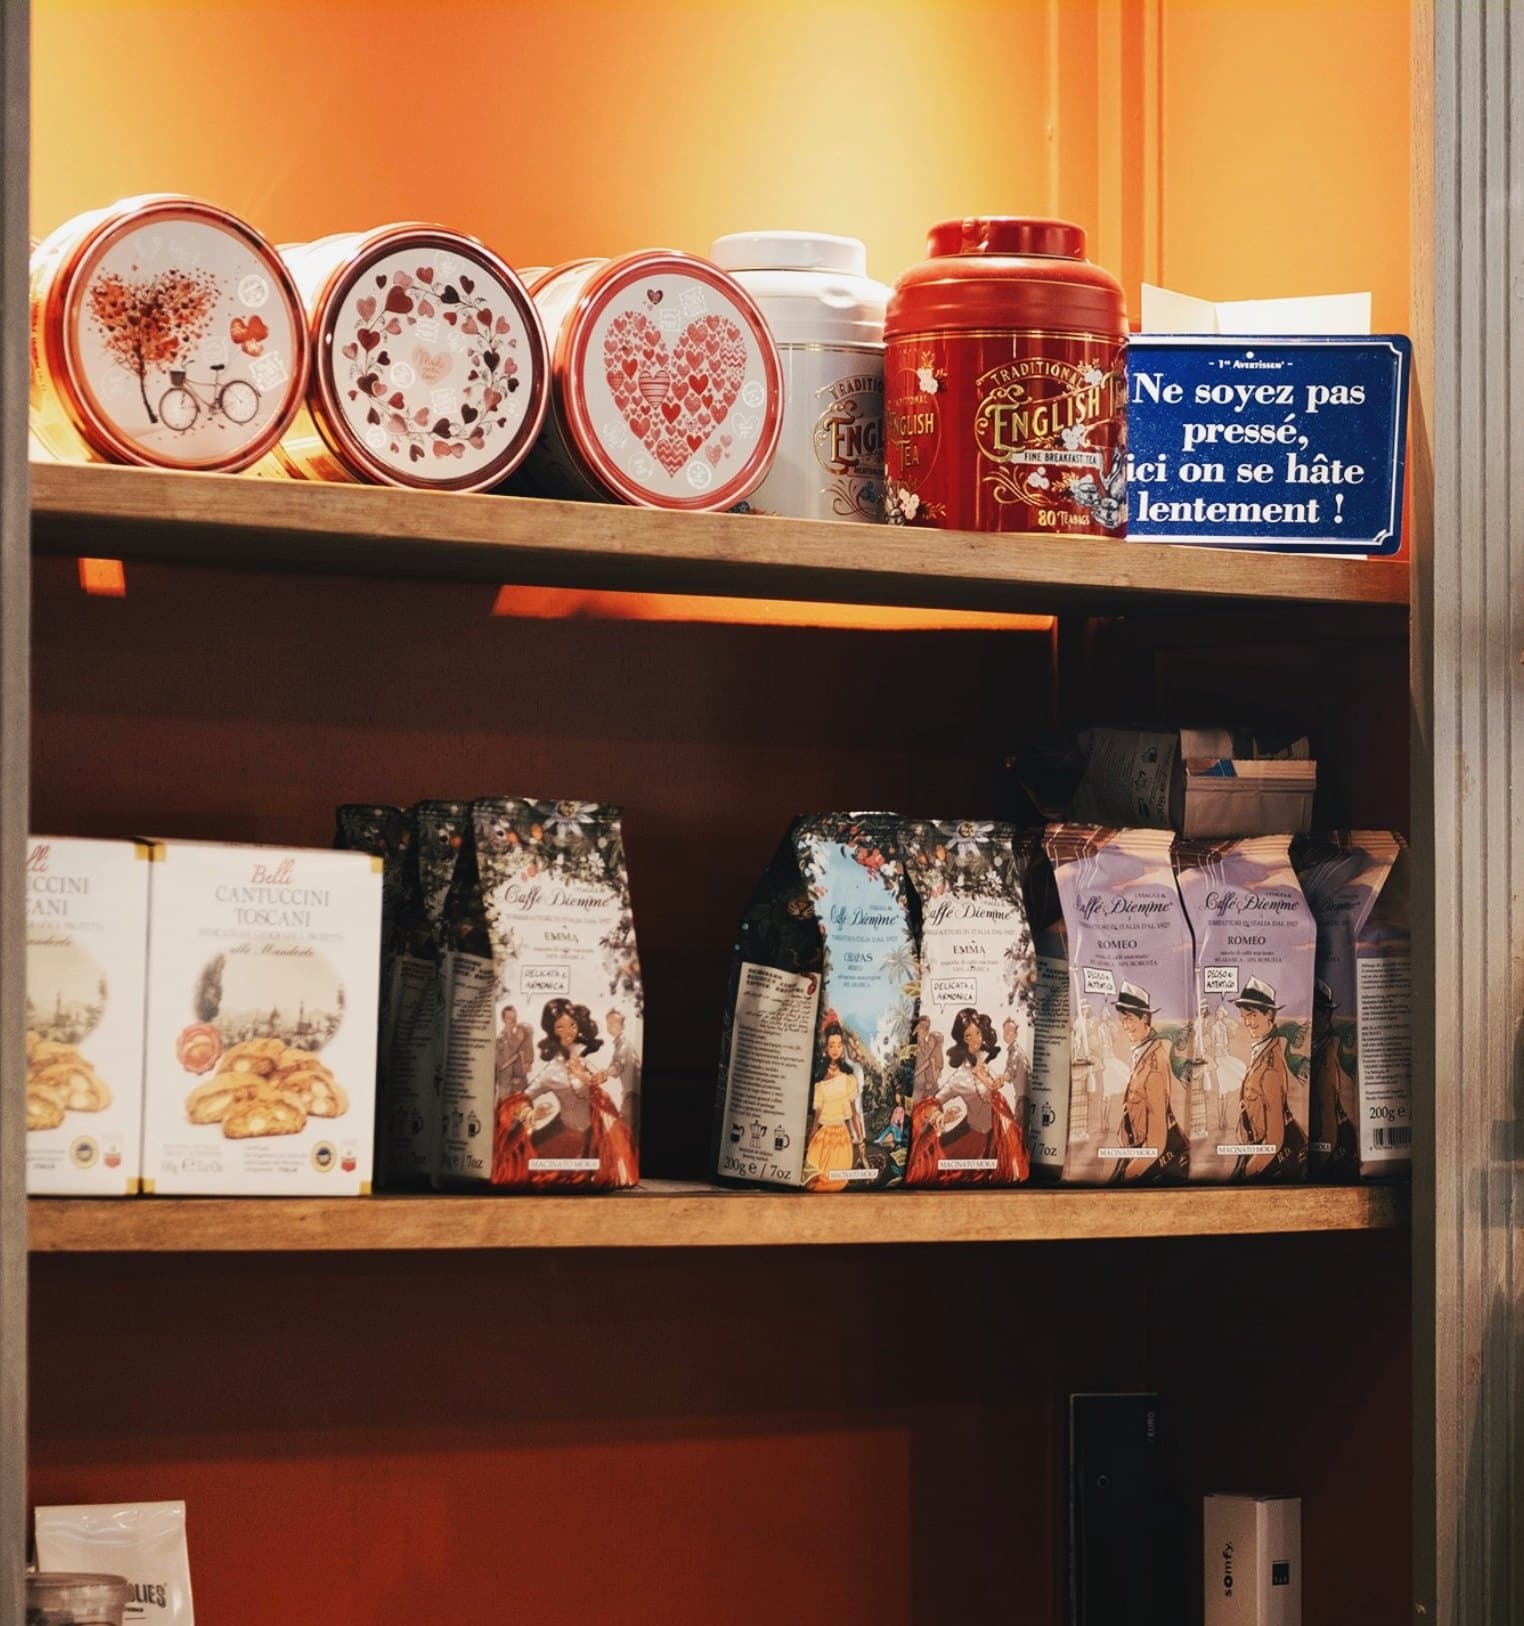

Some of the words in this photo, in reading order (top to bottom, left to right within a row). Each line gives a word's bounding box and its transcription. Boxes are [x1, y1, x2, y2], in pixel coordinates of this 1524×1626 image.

[990, 361, 1084, 388] TRADITIONAL
[1132, 372, 1183, 404] Ne
[1195, 384, 1294, 412] soyez
[1305, 384, 1366, 413] pas
[984, 386, 1100, 452] ENGLISH
[1182, 413, 1309, 451] pressé,
[896, 439, 919, 472] TEA
[1024, 452, 1041, 462] FINE
[1044, 452, 1083, 464] BREAKFAST
[1127, 453, 1168, 482] ici
[1179, 462, 1226, 483] on
[1237, 463, 1274, 484] se
[1285, 453, 1365, 484] hâte
[1136, 490, 1320, 523] lentement
[1038, 510, 1056, 526] 80
[250, 857, 296, 885] Belli
[214, 885, 330, 907] CANTUCCINI
[546, 888, 610, 911] Diemme
[1106, 896, 1170, 917] Diemme
[1240, 893, 1300, 914] Diemme
[234, 908, 312, 927] TOSCANI
[958, 901, 1011, 924] Diemme
[1097, 940, 1138, 950] ROMEO
[1227, 936, 1266, 945] ROMEO
[1369, 1106, 1396, 1122] 200g
[770, 1165, 792, 1180] 7oz
